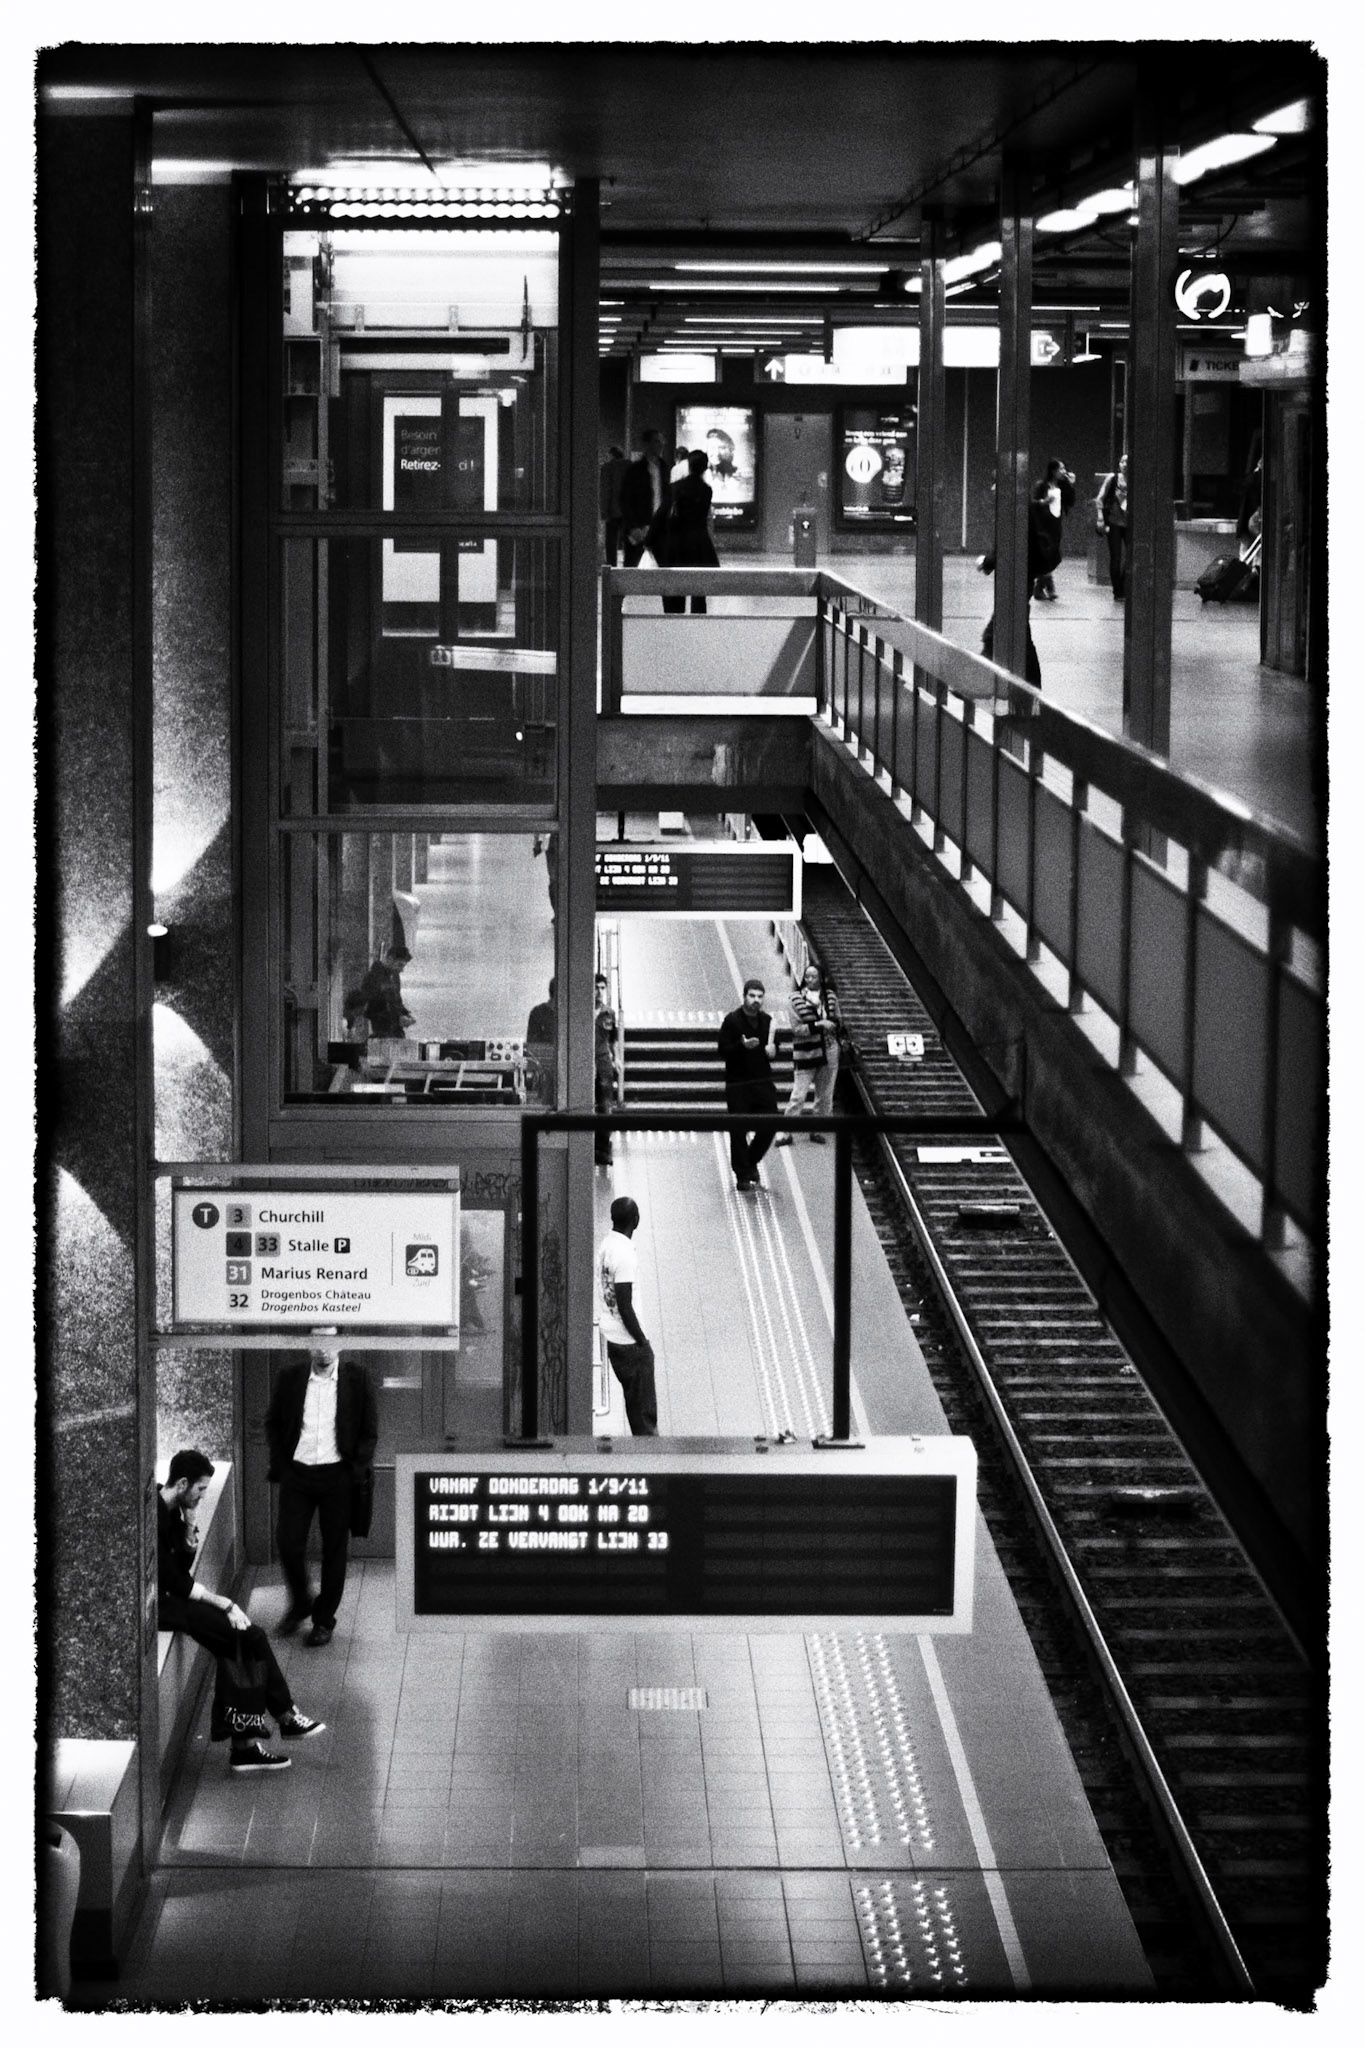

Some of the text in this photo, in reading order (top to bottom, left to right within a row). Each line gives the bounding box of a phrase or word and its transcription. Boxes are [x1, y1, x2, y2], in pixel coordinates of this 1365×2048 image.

[1204, 360, 1240, 371] TICKE
[400, 428, 437, 441] Besoin
[400, 458, 441, 470] Retirez-
[233, 1208, 244, 1223] 3
[258, 1210, 325, 1223] Churchill
[233, 1237, 244, 1250] 4
[258, 1237, 278, 1251] 33
[288, 1239, 330, 1252] Stalle
[229, 1265, 368, 1281] 31 Marius Renard
[229, 1293, 249, 1308] 32
[261, 1289, 371, 1302] Drogenbos Château
[261, 1302, 361, 1314] Drogenbos Kasteel
[429, 1477, 649, 1495] VANAF DONDERDAG 1/9/11
[429, 1504, 650, 1522] RIJDT LIJN 4 OOK NA 20
[429, 1531, 669, 1550] UUR. ZE VERVANGT LIJN 33
